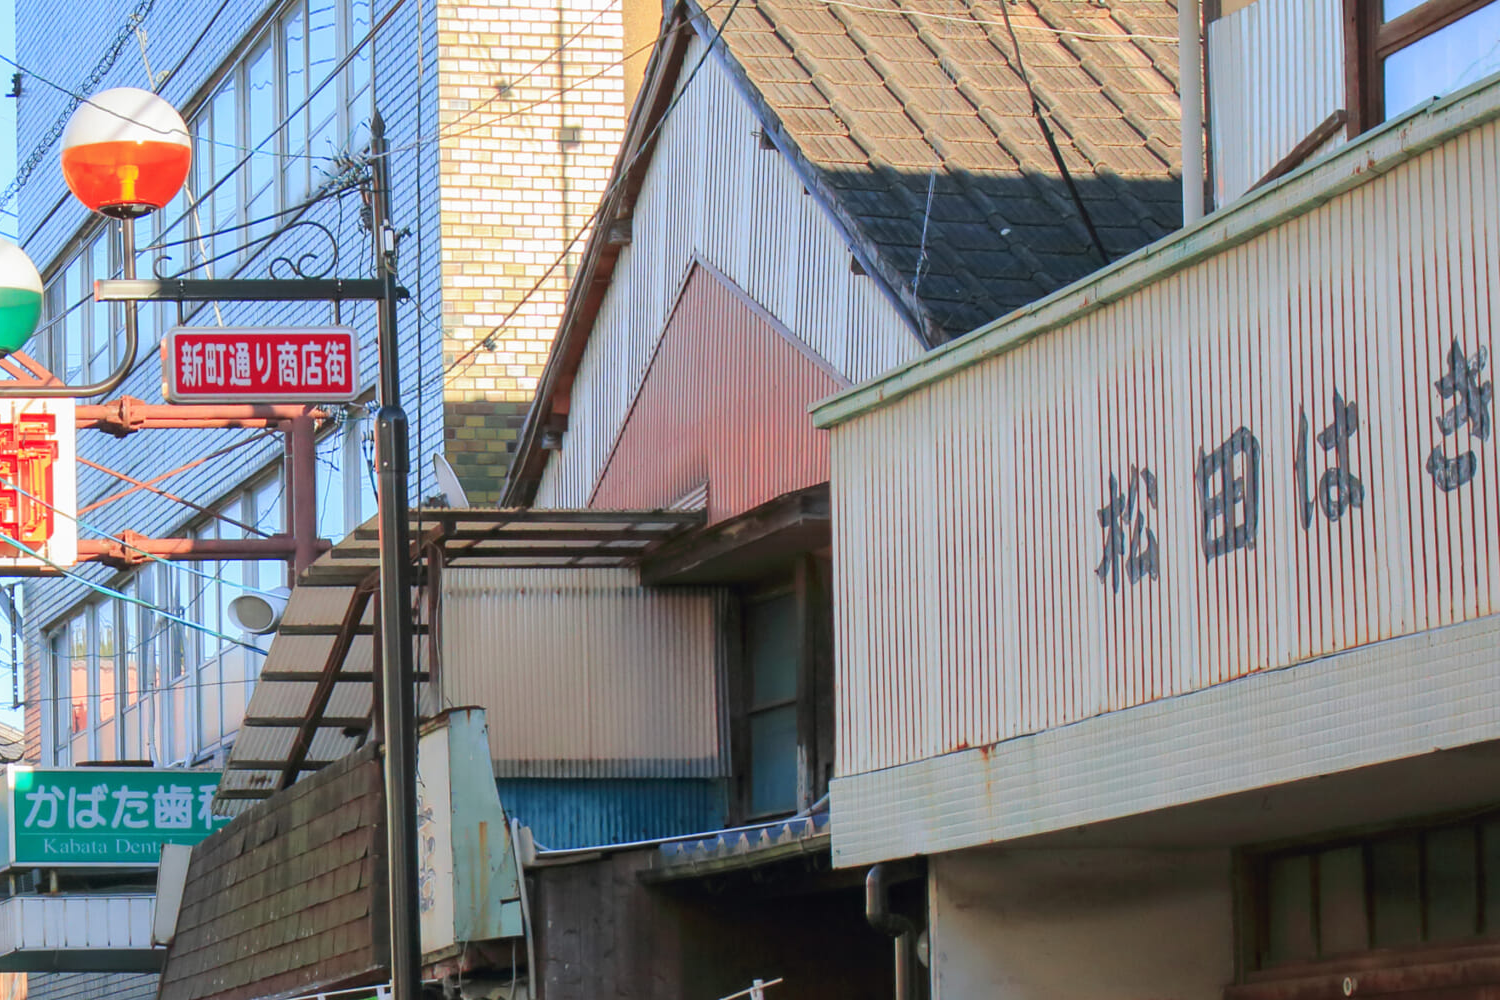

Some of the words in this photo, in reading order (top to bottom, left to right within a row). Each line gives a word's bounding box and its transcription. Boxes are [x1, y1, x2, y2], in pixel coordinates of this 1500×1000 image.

[180, 340, 346, 387] 新町通り商店街
[44, 838, 107, 854] Kabata
[116, 838, 172, 854] Dent
